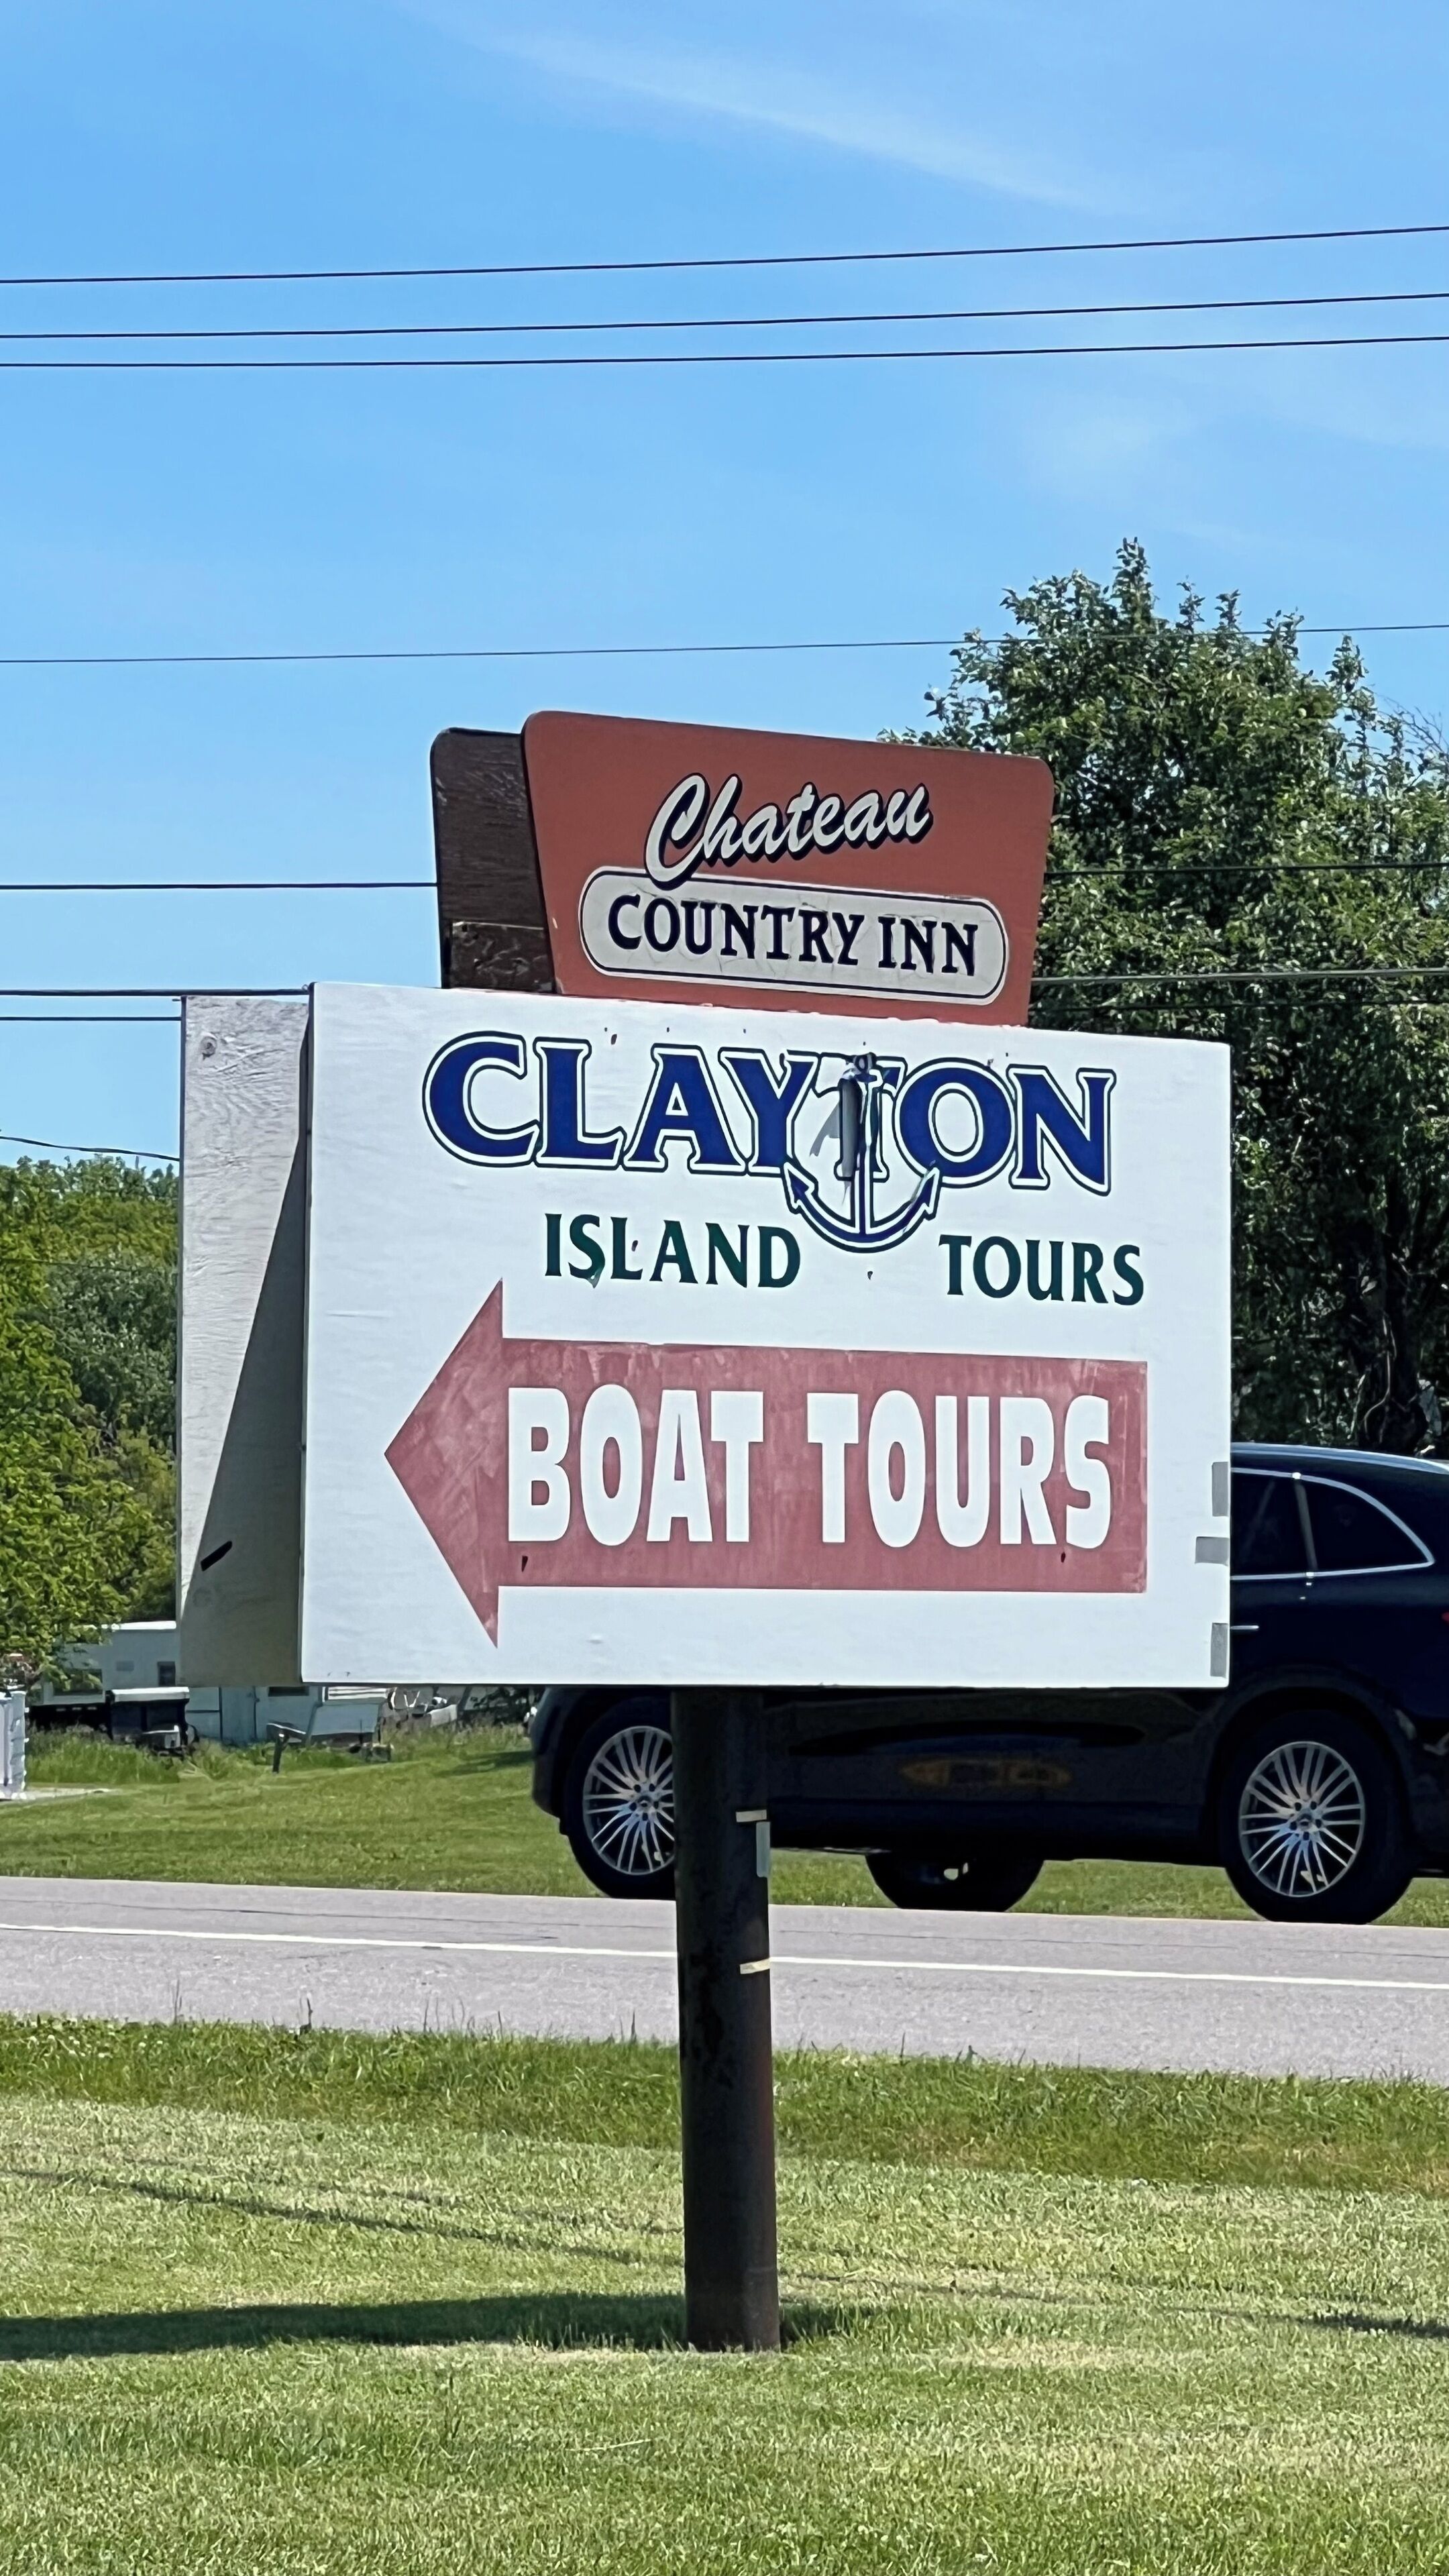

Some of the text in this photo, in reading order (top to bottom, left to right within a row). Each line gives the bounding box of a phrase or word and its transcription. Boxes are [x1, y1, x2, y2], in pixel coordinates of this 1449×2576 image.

[644, 772, 933, 890] Chateau
[608, 894, 979, 977] COUNTRY INN
[422, 1030, 1117, 1196] CLAYTON
[545, 1213, 1144, 1306] ISLAND TOURS
[508, 1384, 1112, 1550] BOAT TOURS
